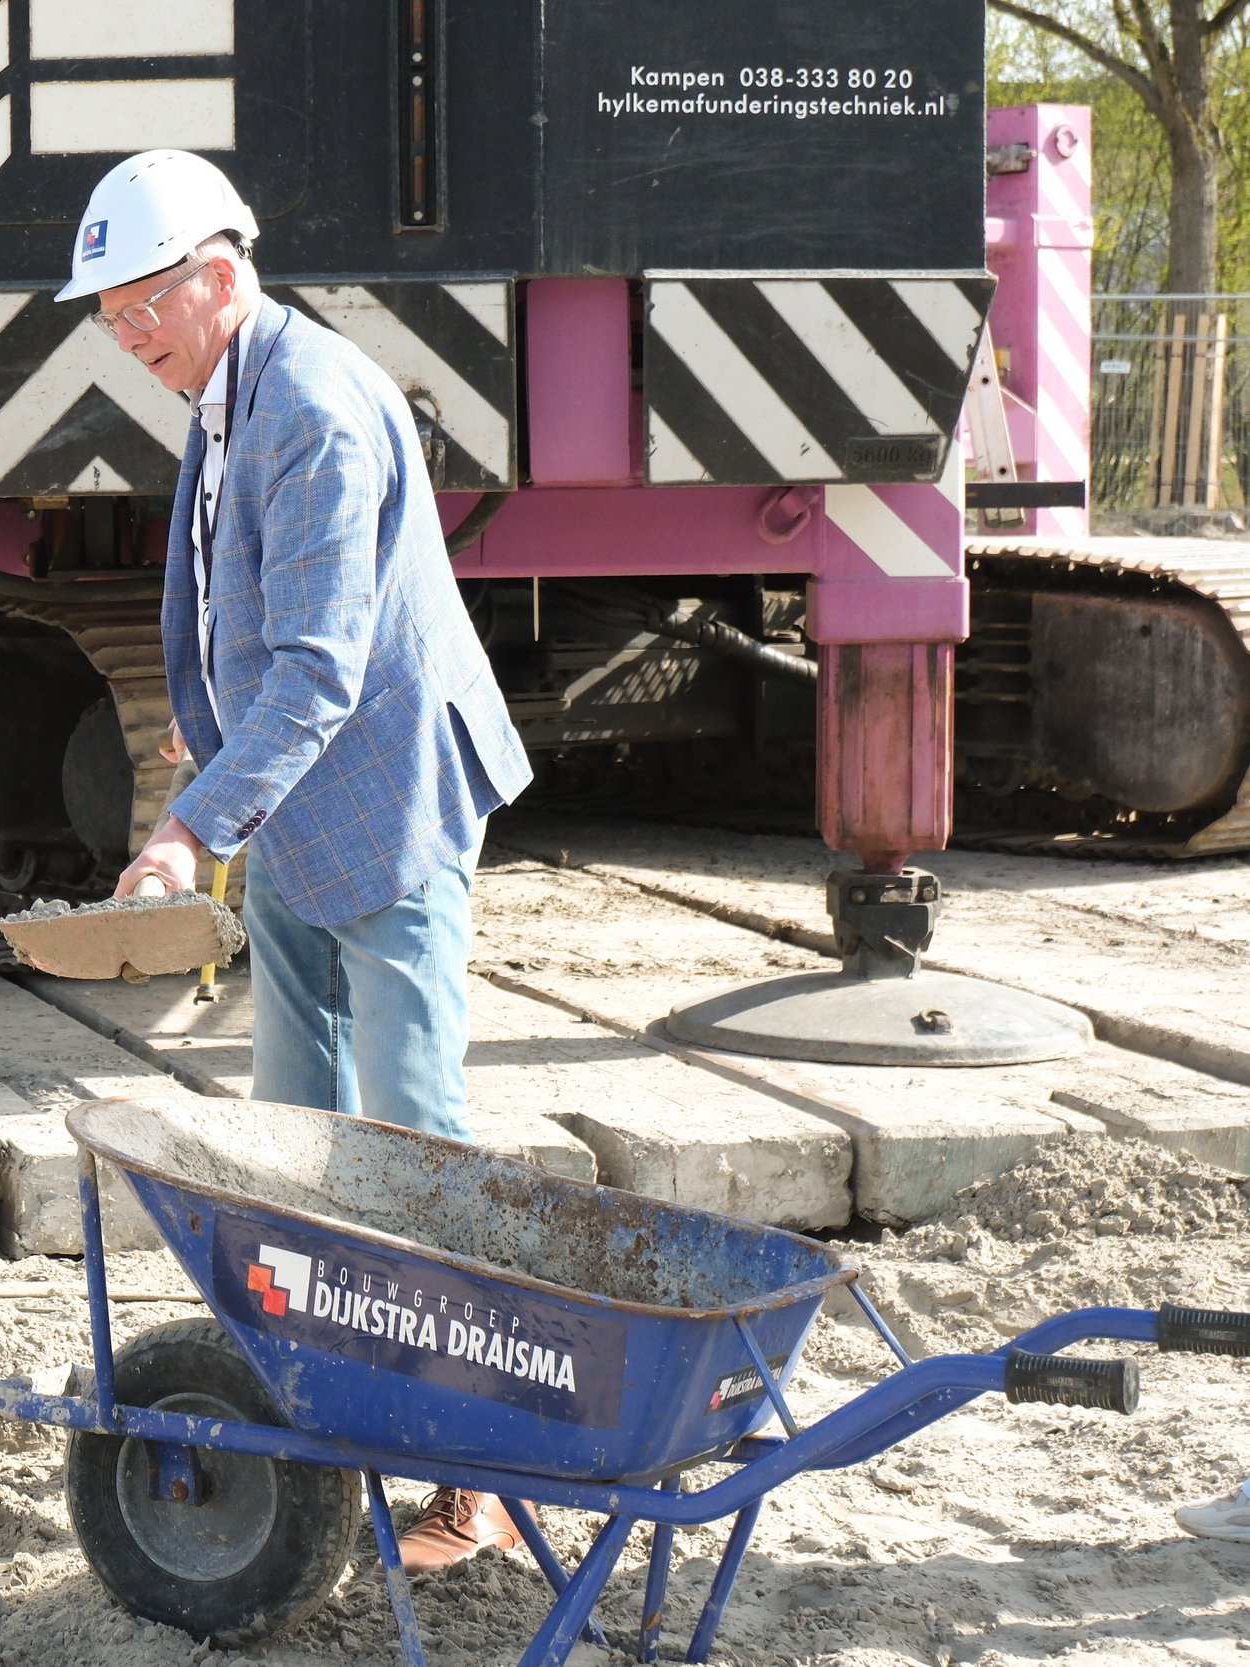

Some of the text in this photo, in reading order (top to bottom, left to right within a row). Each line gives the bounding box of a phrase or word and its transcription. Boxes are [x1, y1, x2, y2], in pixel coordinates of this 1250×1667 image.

[630, 66, 912, 91] Kampen 038-333 80 20
[598, 92, 945, 119] hylkemafunderingstechniek.nl
[317, 1259, 520, 1334] BOUWGROEP
[313, 1281, 577, 1393] DIJKSTRA DRAISMA
